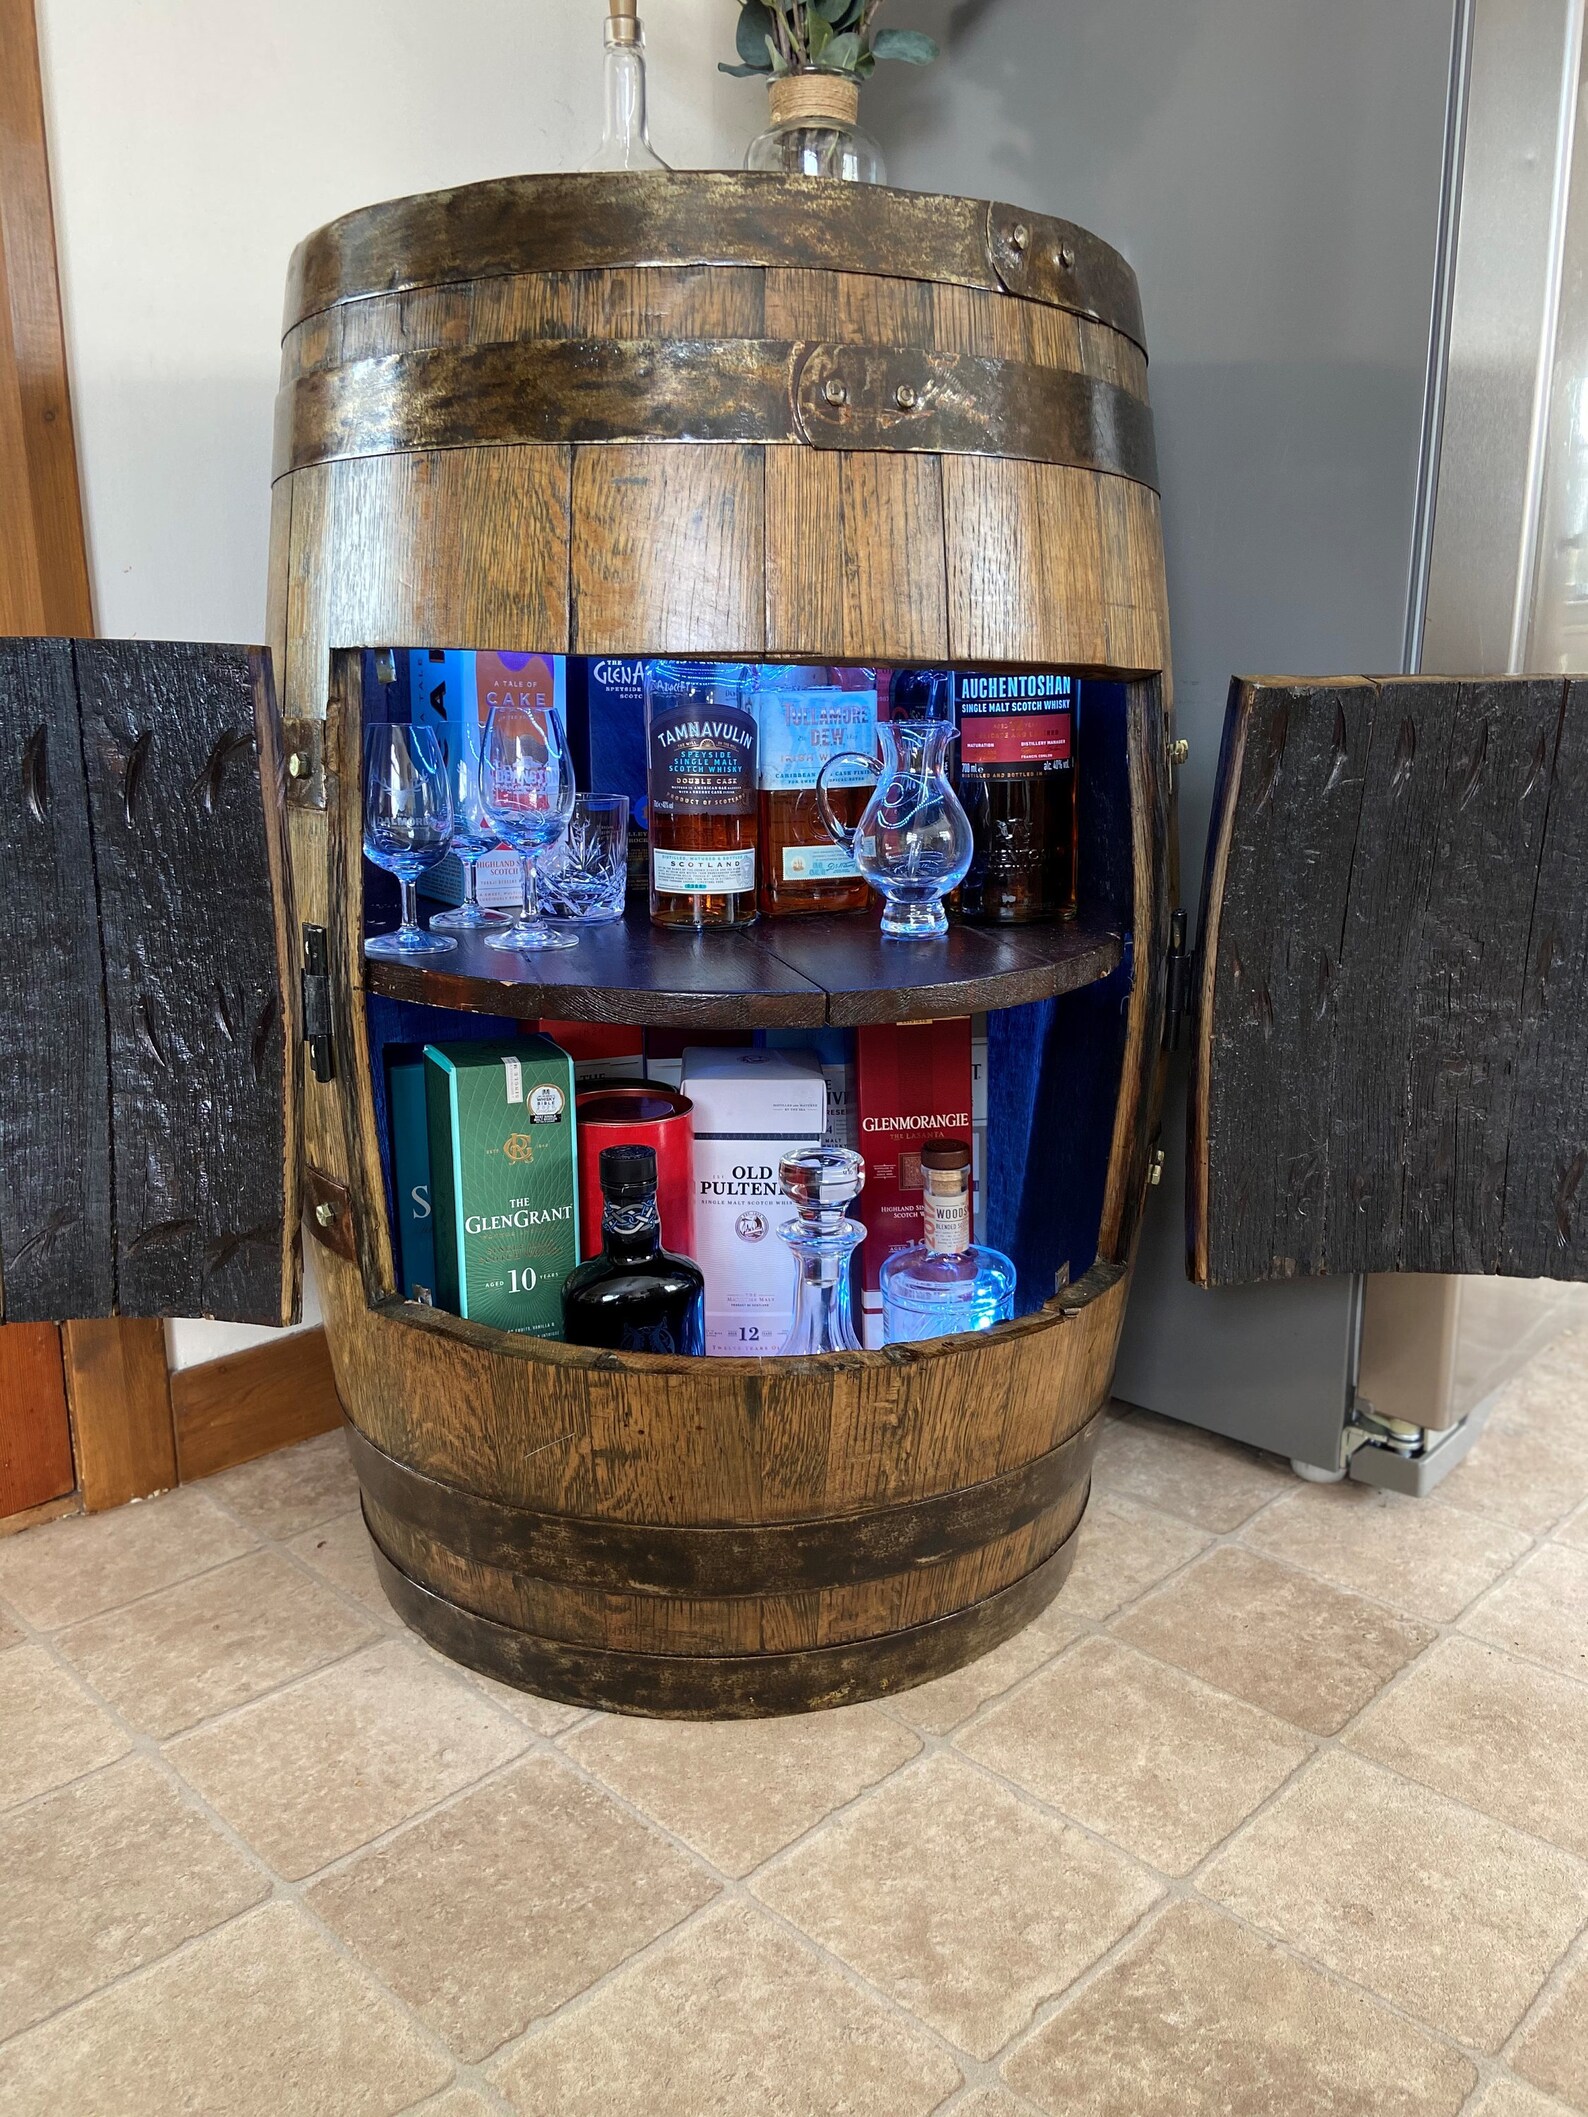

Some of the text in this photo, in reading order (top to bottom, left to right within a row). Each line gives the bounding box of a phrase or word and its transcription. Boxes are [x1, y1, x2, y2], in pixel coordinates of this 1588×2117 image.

[503, 680, 524, 688] TALE
[962, 675, 1071, 699] AUCHENTOSHAN
[486, 691, 546, 707] CAKE
[962, 700, 1071, 713] SINGLE MALT SCOTCH WHISKY
[783, 703, 869, 727] TULLAMORE
[658, 721, 754, 750] TAMNAVULIN
[674, 758, 709, 766] SINGLE
[477, 860, 514, 868] HIGHLAND
[670, 860, 741, 868] SCOTLAND
[490, 868, 519, 876] SCOTCH
[862, 1112, 970, 1132] GLENMORANGIE
[732, 1165, 773, 1180] OLD
[700, 1181, 785, 1196] PULTEN
[509, 1197, 530, 1208] THE
[881, 1205, 915, 1213] HIGHLAND
[465, 1204, 572, 1235] GLENGRANT
[485, 1267, 559, 1294] AGED 10 YEARS
[739, 1326, 760, 1341] 12
